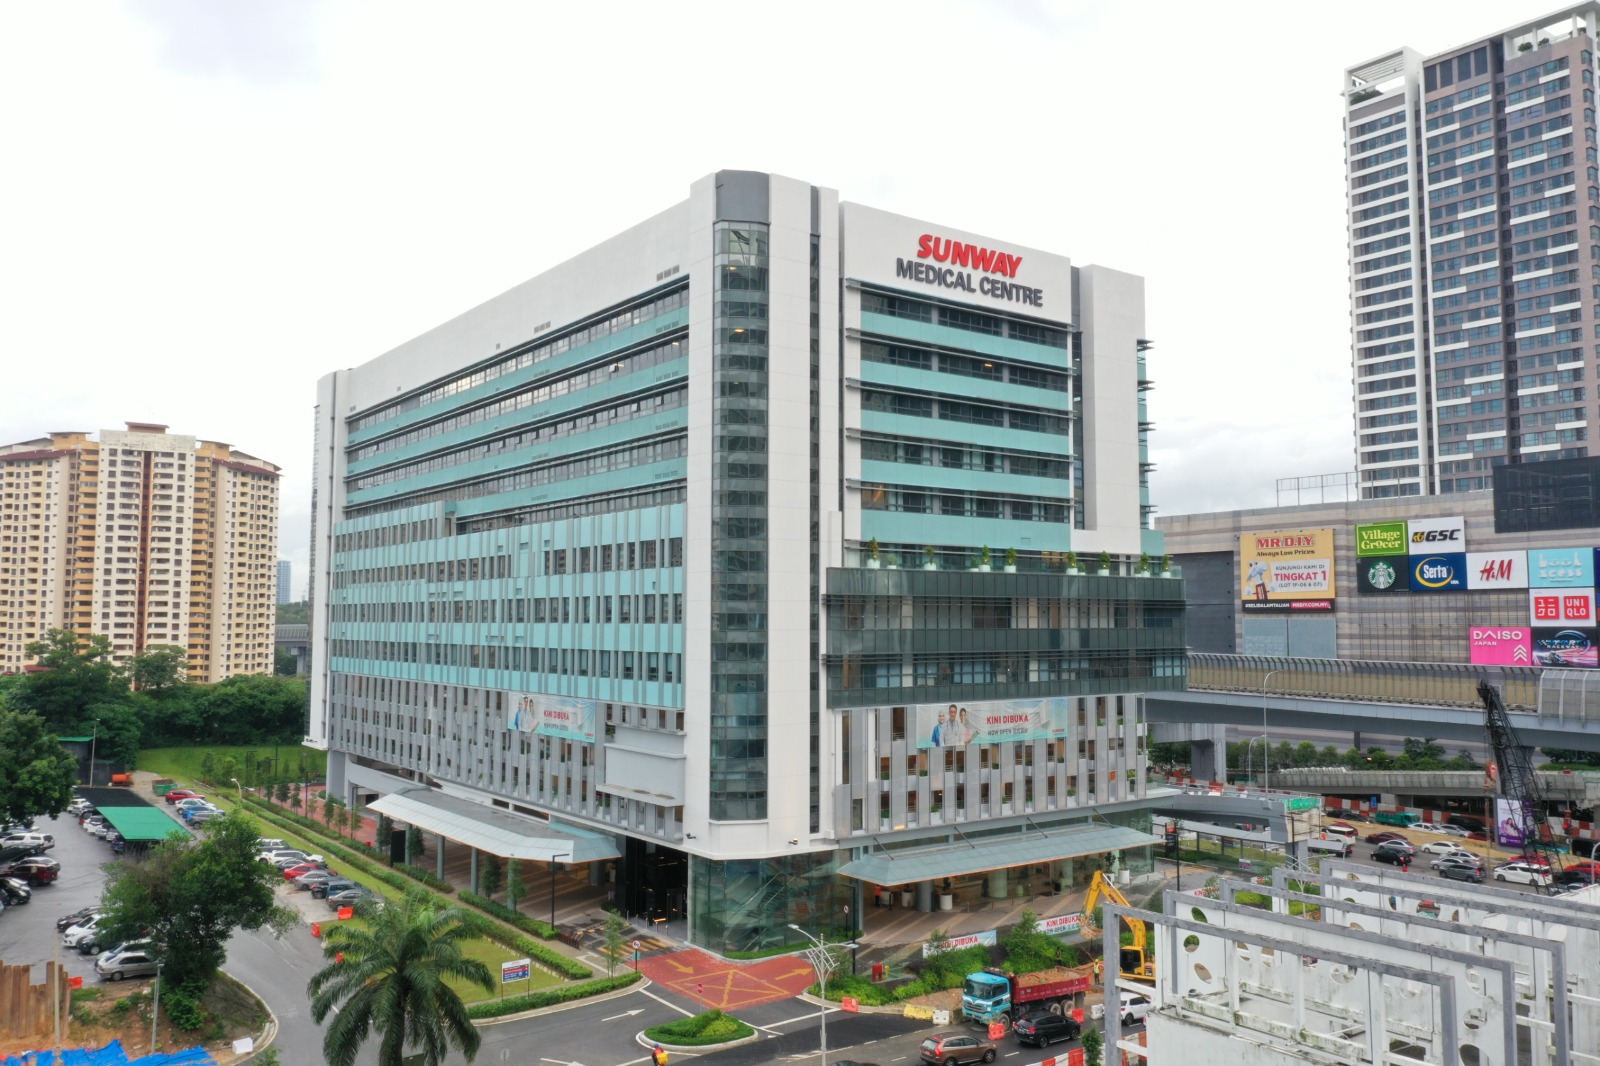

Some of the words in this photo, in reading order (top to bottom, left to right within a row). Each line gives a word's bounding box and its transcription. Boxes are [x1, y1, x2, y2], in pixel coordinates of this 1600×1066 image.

[916, 233, 1024, 279] SUNWAY
[896, 257, 977, 293] MEDICAL
[979, 275, 1044, 308] CENTRE
[1360, 529, 1400, 541] Village
[1425, 528, 1461, 542] GSC
[1361, 540, 1401, 550] Grocer
[1539, 551, 1582, 568] book
[1274, 572, 1318, 581] TINGKAT
[1321, 570, 1327, 581] 1
[1423, 564, 1448, 579] Serta
[1479, 559, 1513, 582] H&M
[1566, 598, 1584, 607] UNI
[1566, 607, 1587, 617] QLO
[1473, 630, 1523, 641] DAISO
[986, 716, 1002, 724] KINI
[1002, 714, 1028, 724] DIBUKA
